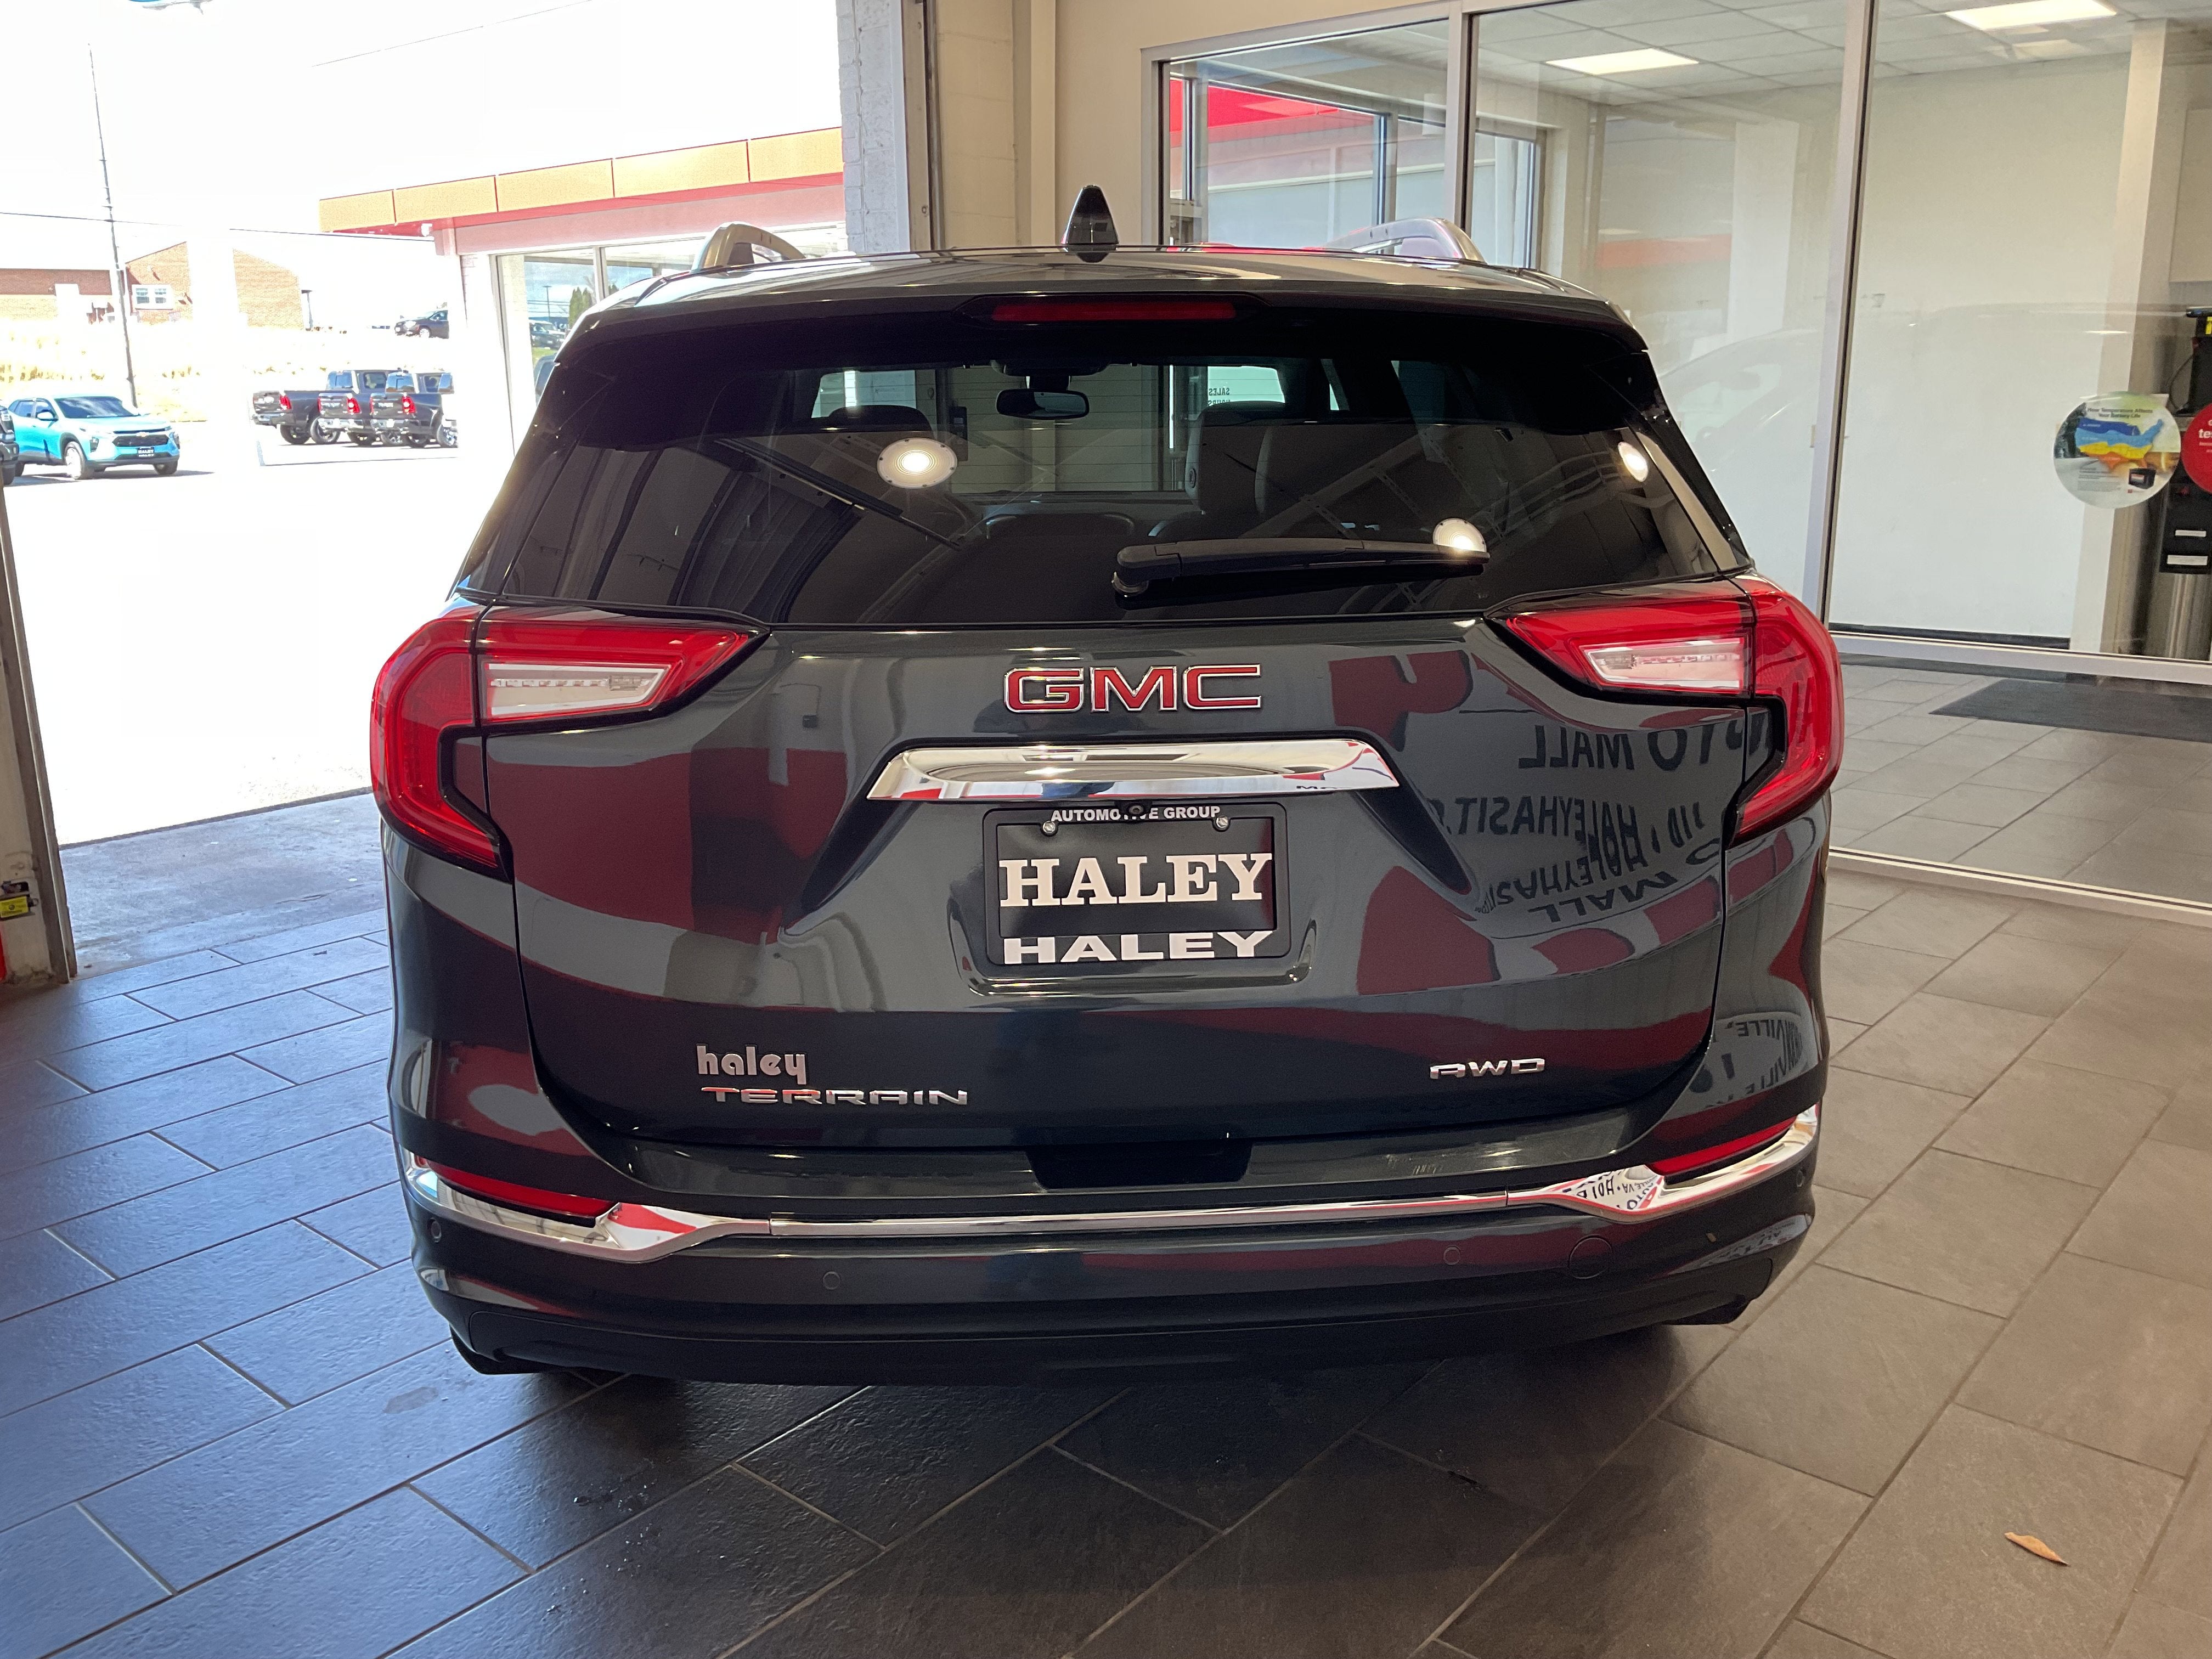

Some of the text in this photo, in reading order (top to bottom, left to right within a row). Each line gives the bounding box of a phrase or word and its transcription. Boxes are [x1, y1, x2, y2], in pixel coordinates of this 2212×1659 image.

[1004, 664, 1262, 713] GMC
[1163, 805, 1221, 819] GROUP
[999, 853, 1273, 907] HALEY
[1004, 931, 1273, 964] HALEY
[696, 1044, 807, 1085] haley
[1429, 1058, 1545, 1080] AWD
[701, 1087, 967, 1105] TERRAIN
